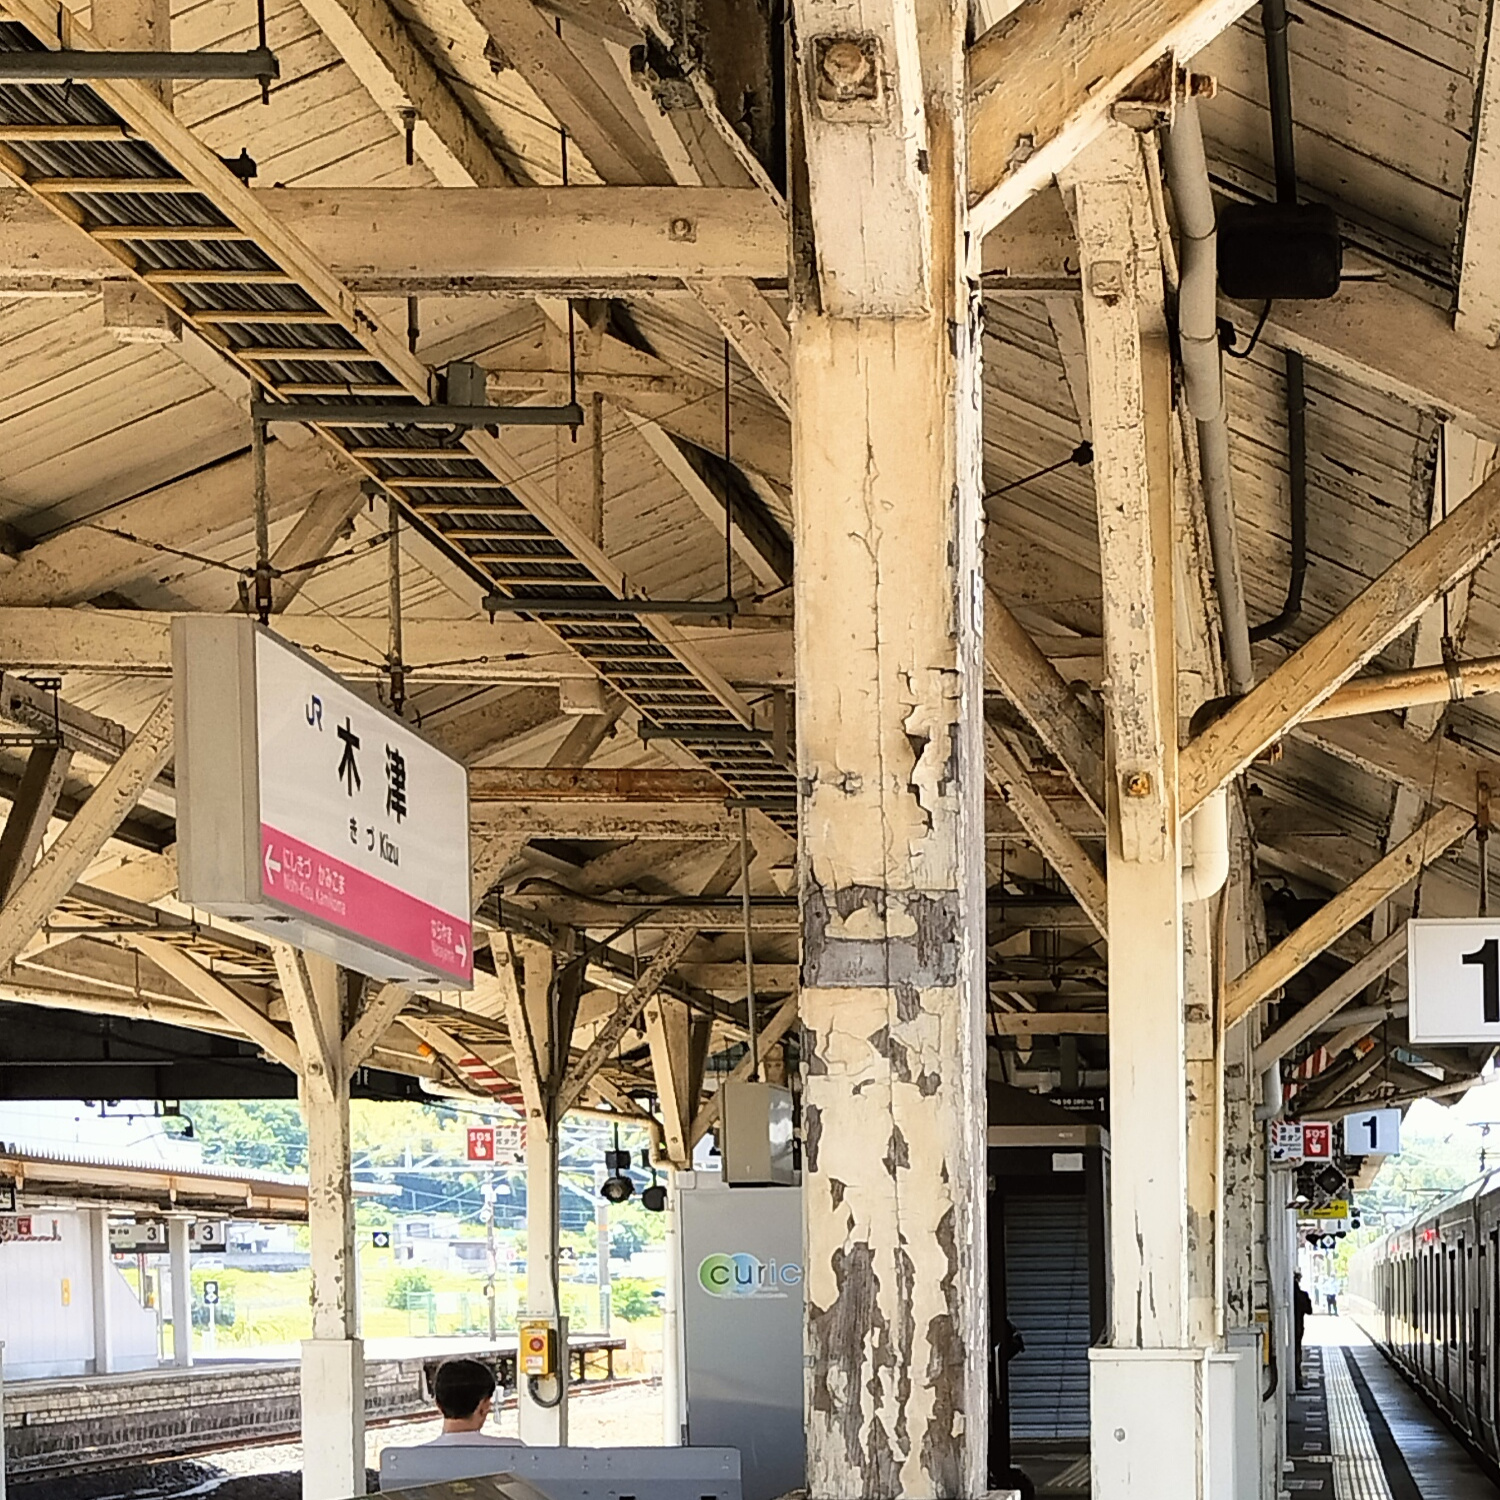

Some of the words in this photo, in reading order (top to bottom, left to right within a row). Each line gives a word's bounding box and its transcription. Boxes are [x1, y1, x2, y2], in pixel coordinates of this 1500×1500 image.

[306, 695, 322, 731] JR
[337, 716, 407, 824] 木津
[379, 831, 399, 866] Kizu
[1462, 939, 1500, 1023] 1
[469, 1132, 492, 1142] SOS
[1305, 1129, 1326, 1139] SOS
[1362, 1115, 1377, 1149] 1
[147, 1226, 157, 1241] 3
[202, 1225, 214, 1241] 3
